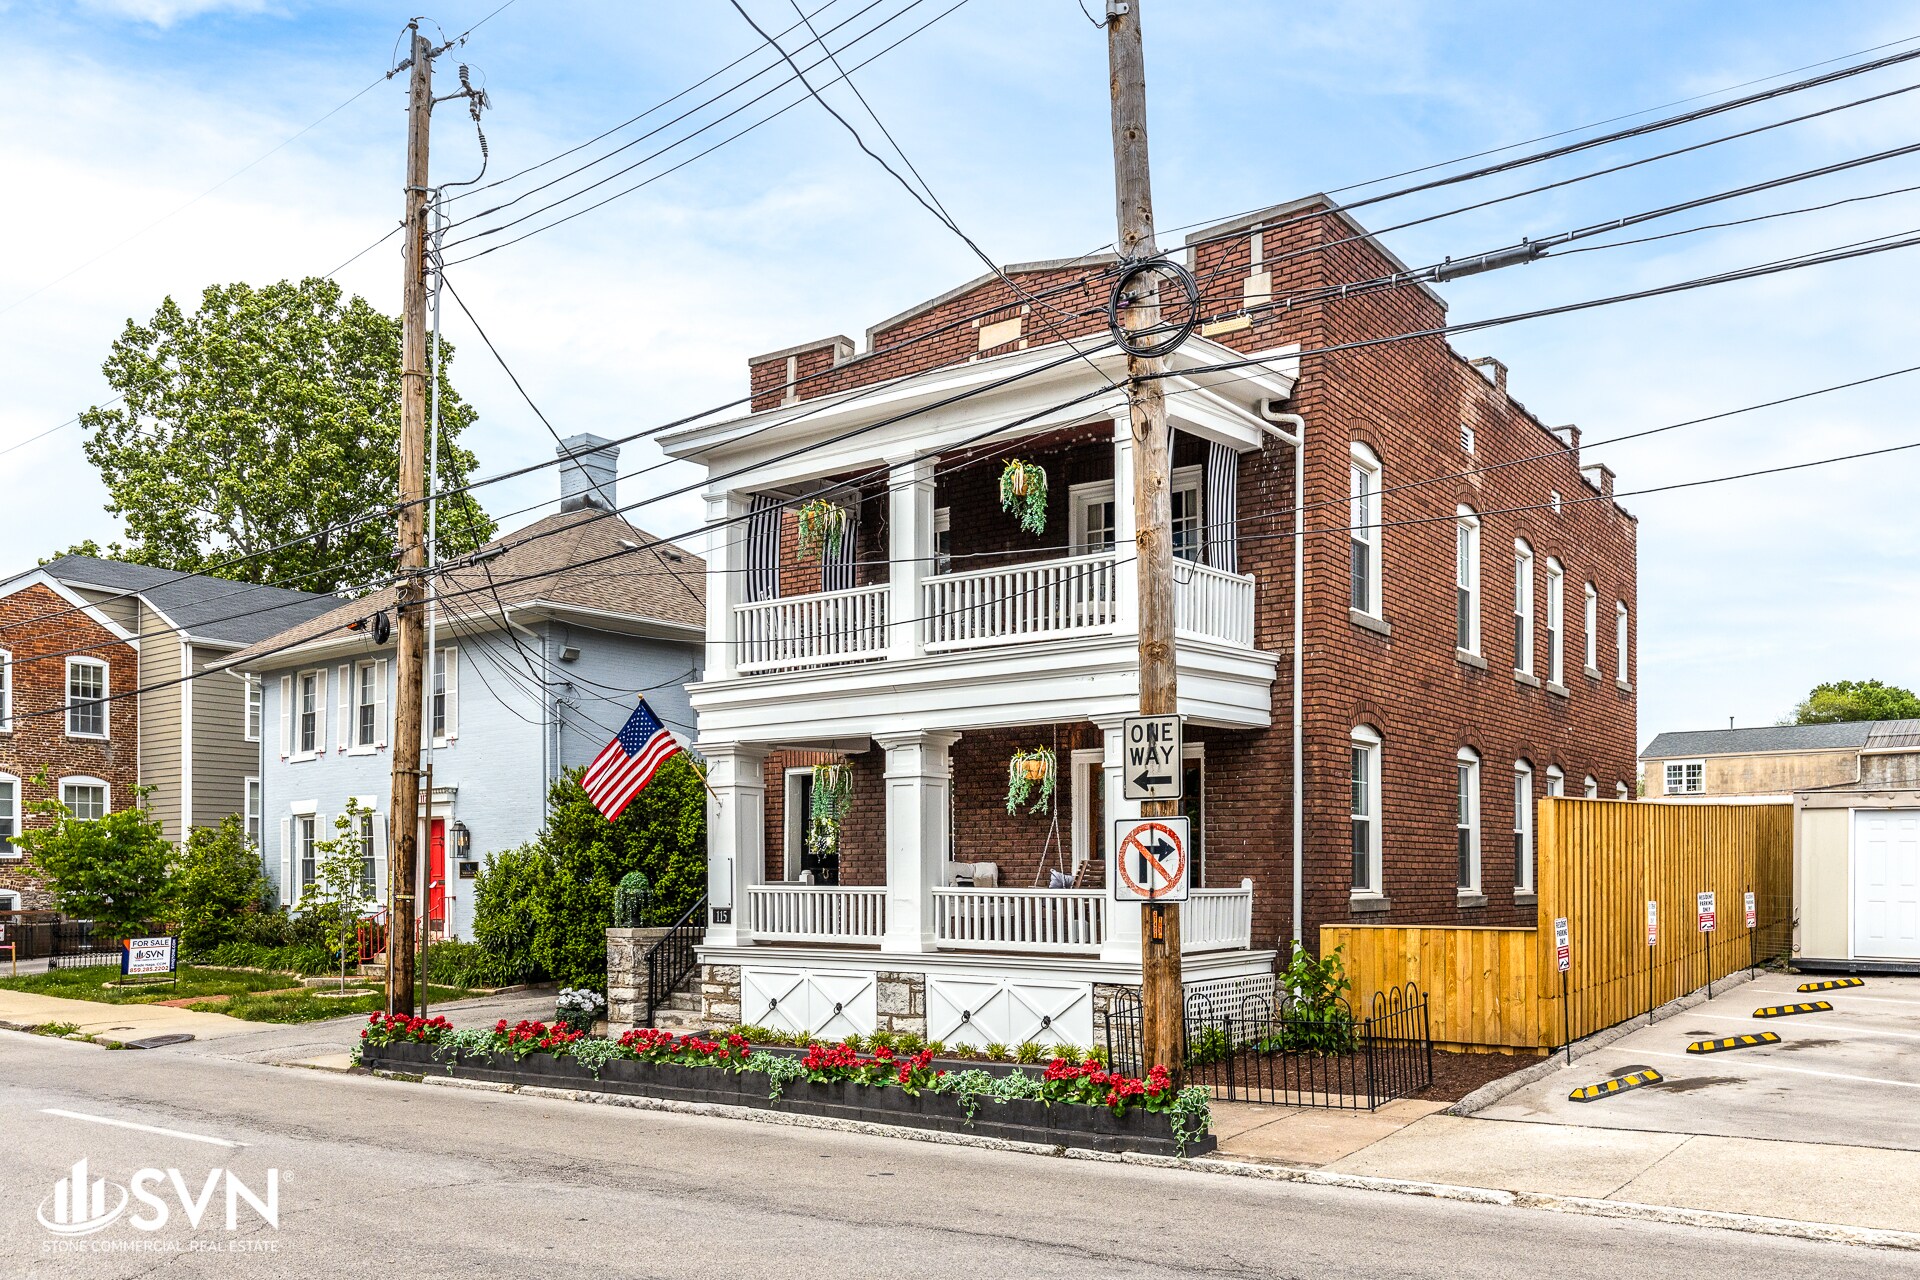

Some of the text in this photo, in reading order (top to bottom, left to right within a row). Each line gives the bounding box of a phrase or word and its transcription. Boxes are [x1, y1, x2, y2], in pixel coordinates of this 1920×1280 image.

[1131, 723, 1173, 743] ONE
[1130, 746, 1174, 766] WAY
[716, 910, 728, 922] 115
[145, 950, 164, 959] SVN
